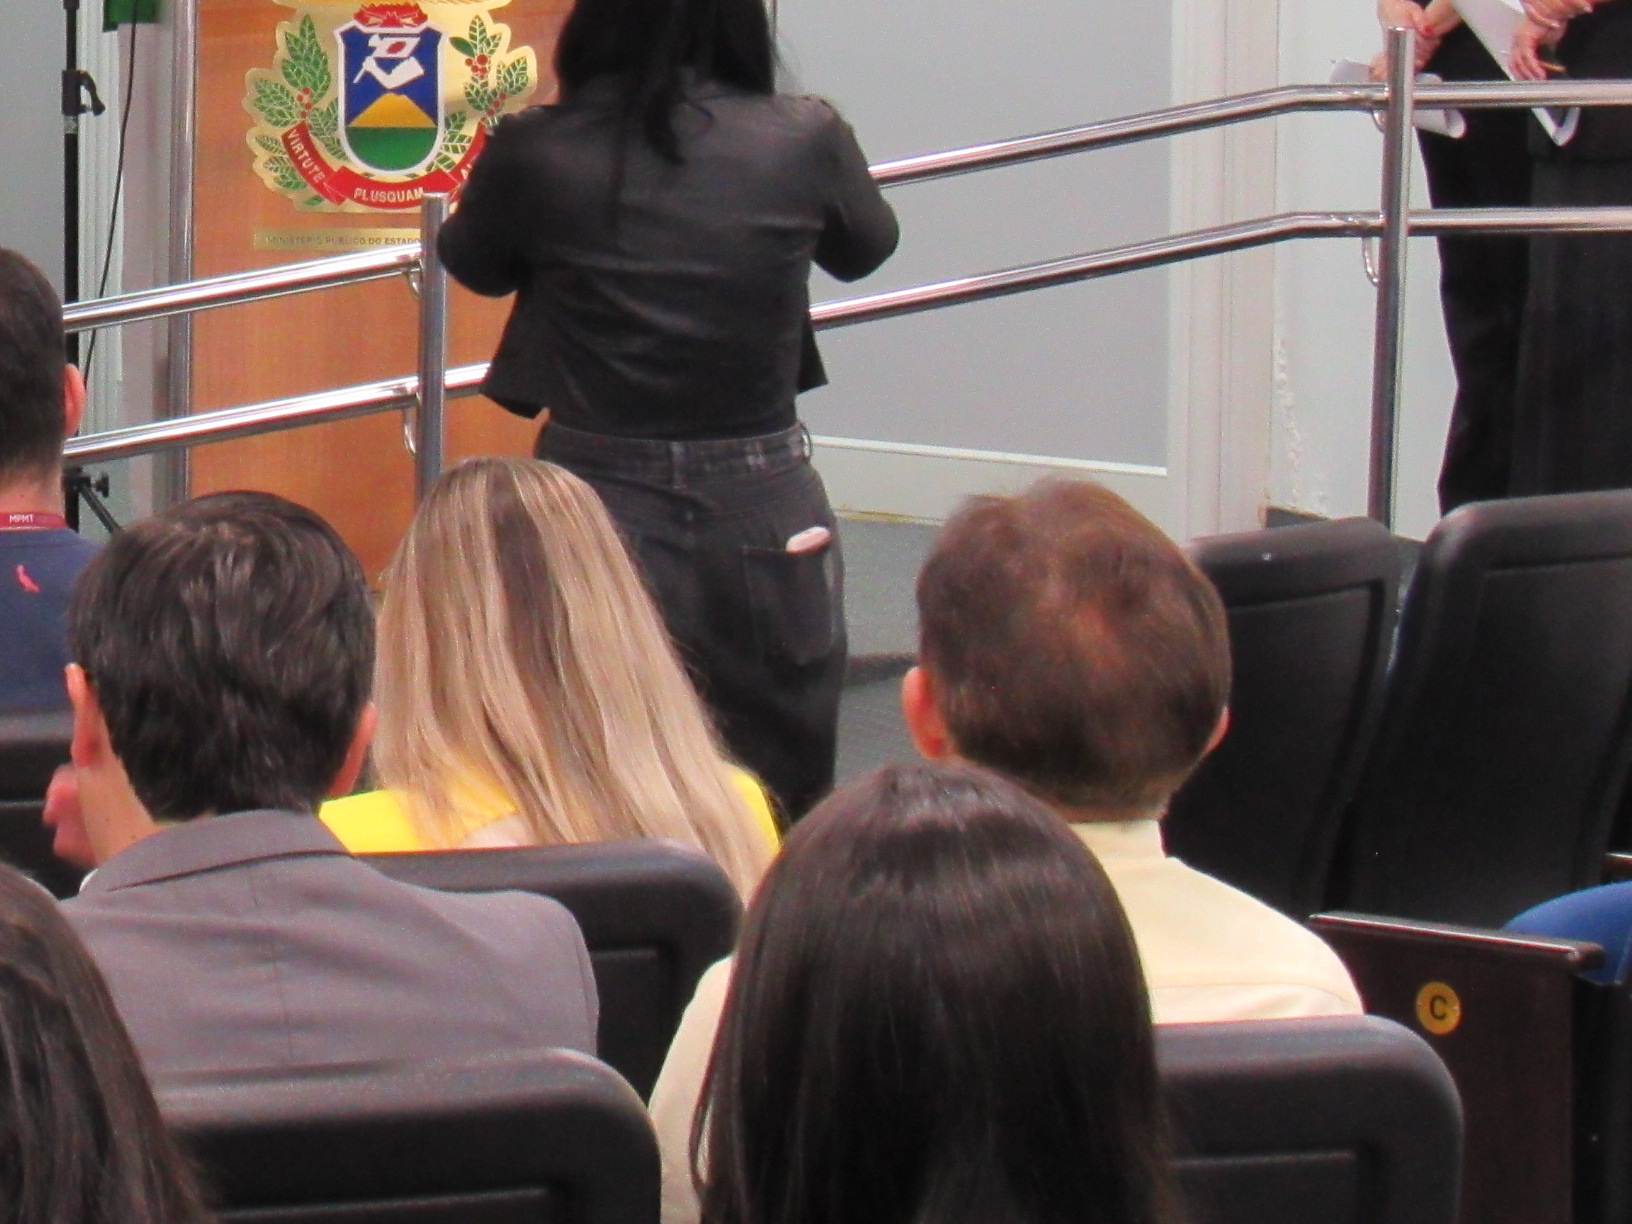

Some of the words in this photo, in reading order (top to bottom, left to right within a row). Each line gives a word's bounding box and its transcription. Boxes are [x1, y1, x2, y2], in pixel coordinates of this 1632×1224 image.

[287, 128, 326, 183] VIRTUTE
[353, 186, 424, 203] PLUSQUAM
[9, 514, 34, 524] MPMT
[1429, 994, 1448, 1021] C
